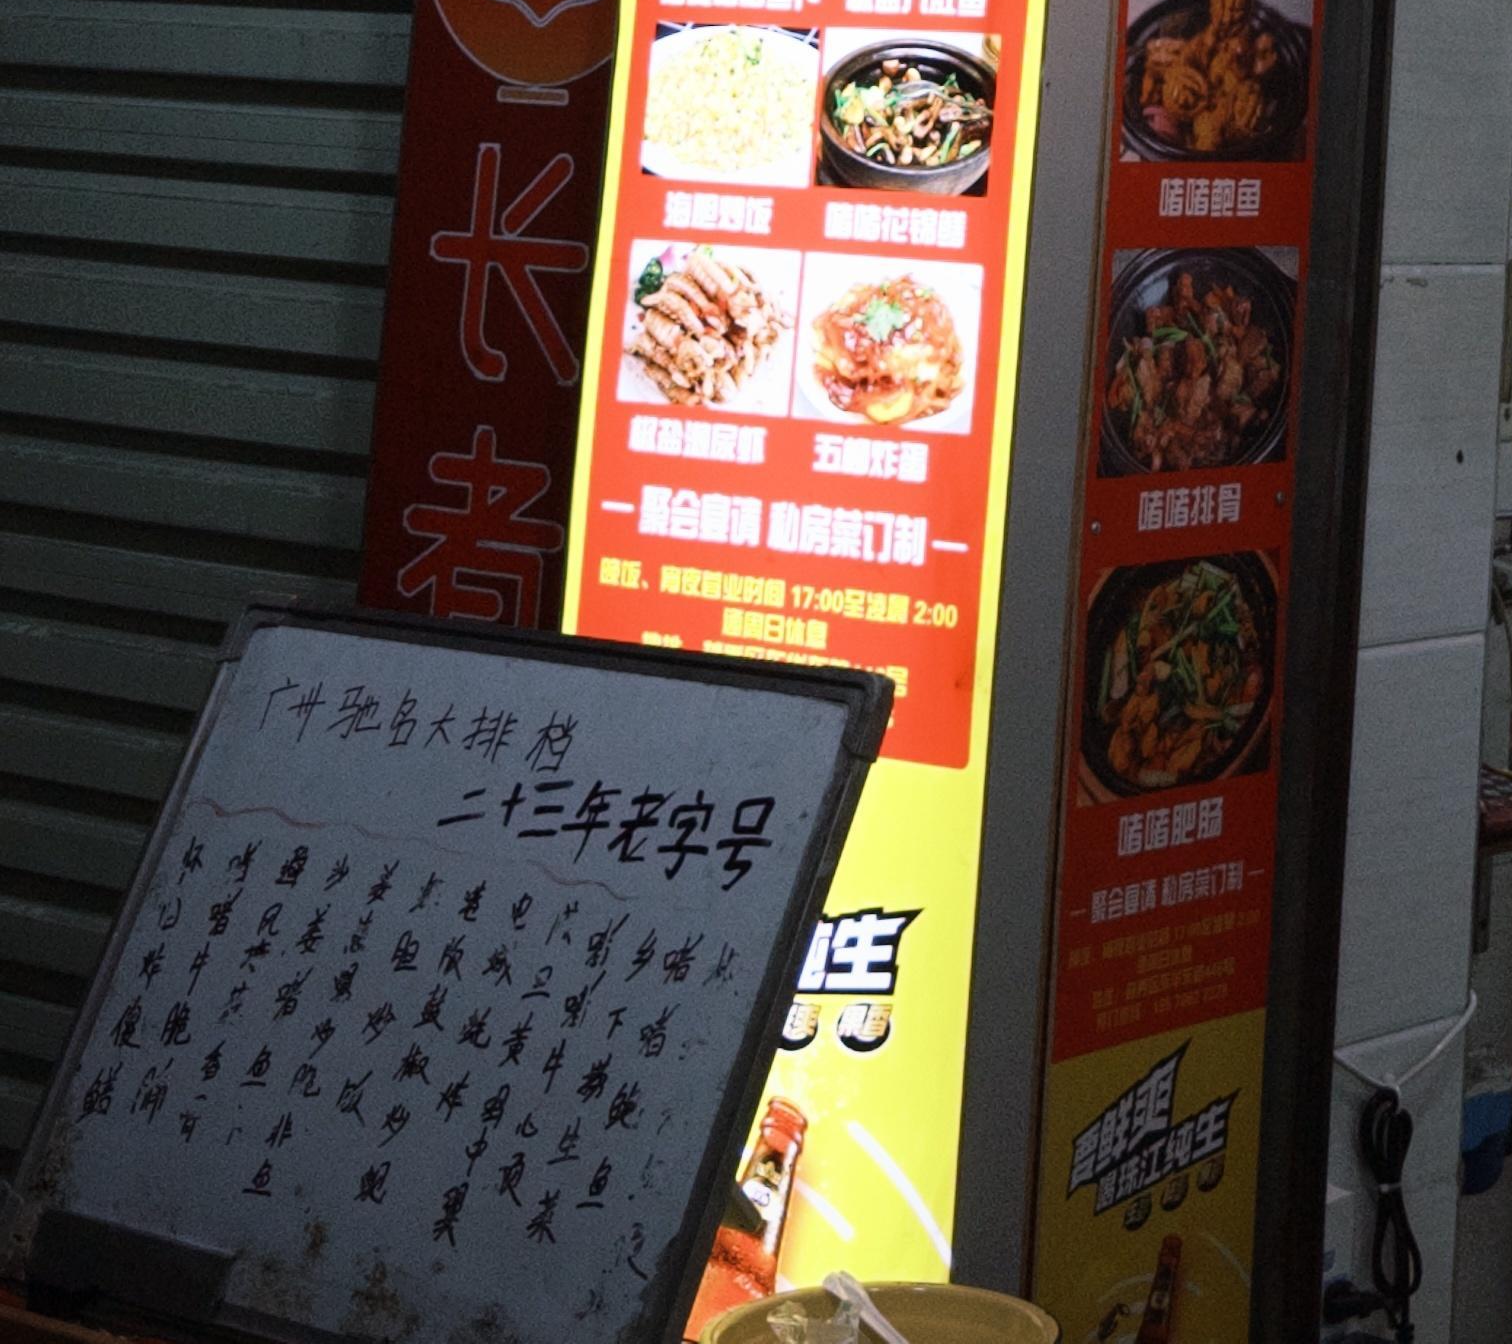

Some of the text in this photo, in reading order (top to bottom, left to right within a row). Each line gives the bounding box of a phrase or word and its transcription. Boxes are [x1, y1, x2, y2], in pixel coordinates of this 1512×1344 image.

[1137, 482, 1242, 532] 啫啫排骨
[913, 600, 958, 628] 2:00
[260, 677, 578, 774] 广州驰名大排档
[438, 780, 777, 890] 二十三年老字号
[1117, 796, 1224, 857] 啫啫肥肠
